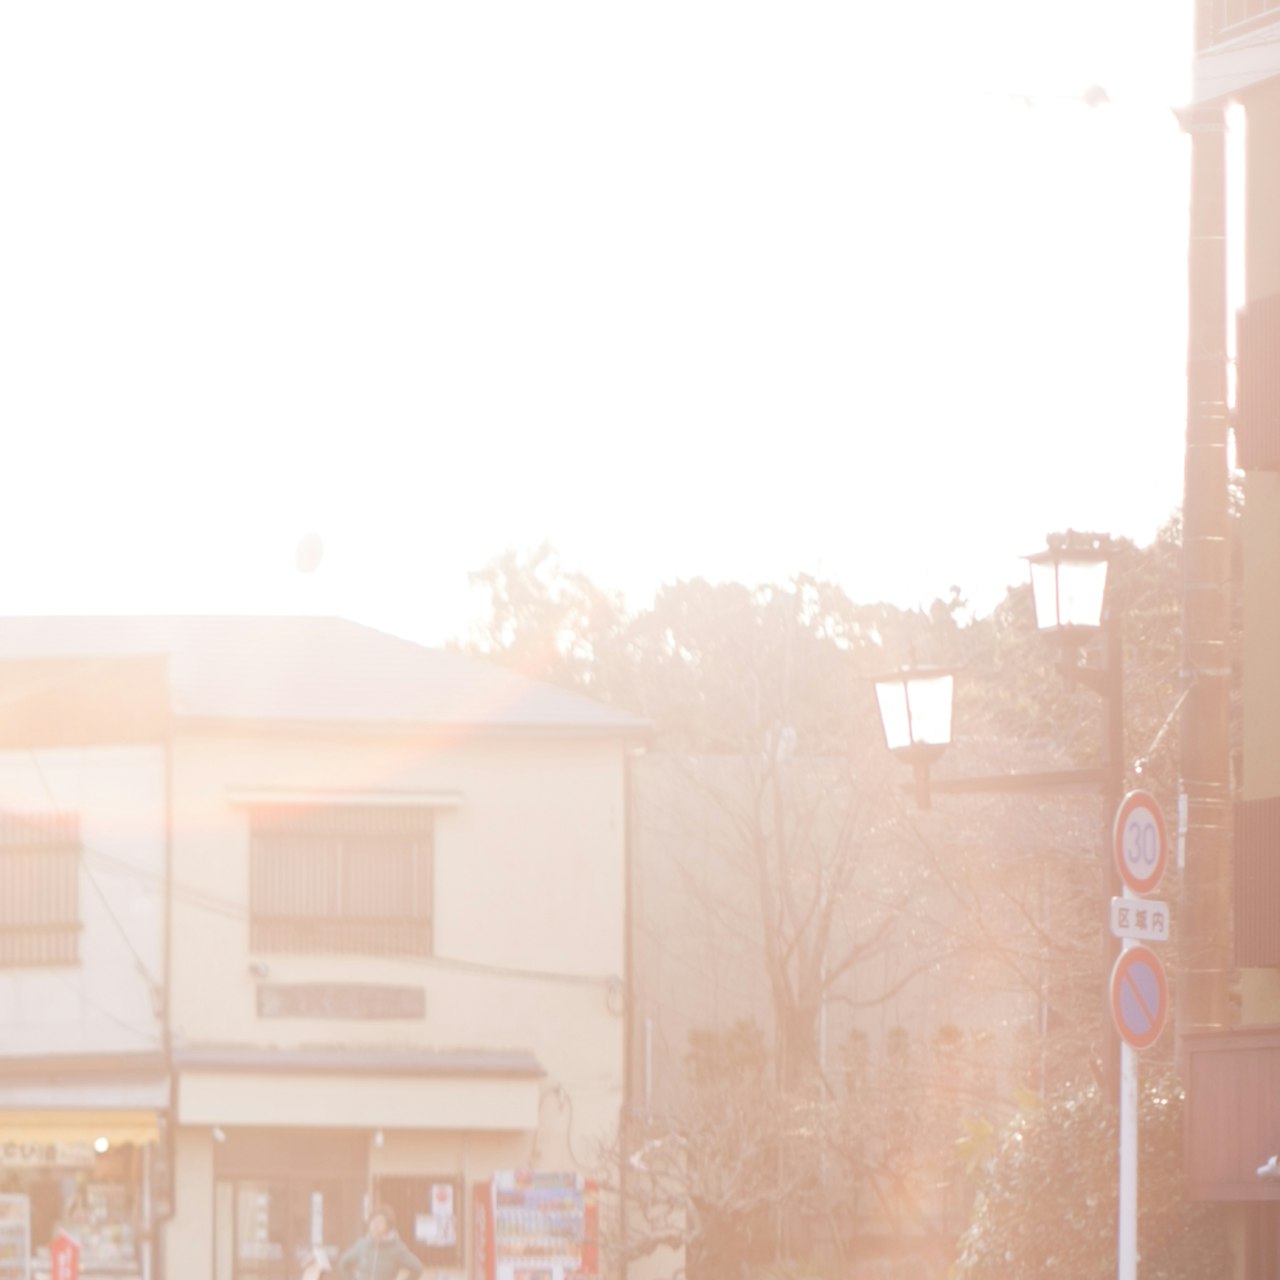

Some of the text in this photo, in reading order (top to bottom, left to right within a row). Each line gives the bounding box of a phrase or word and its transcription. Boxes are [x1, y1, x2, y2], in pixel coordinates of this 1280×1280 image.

[1128, 822, 1158, 865] 30
[1117, 907, 1165, 933] 区域内
